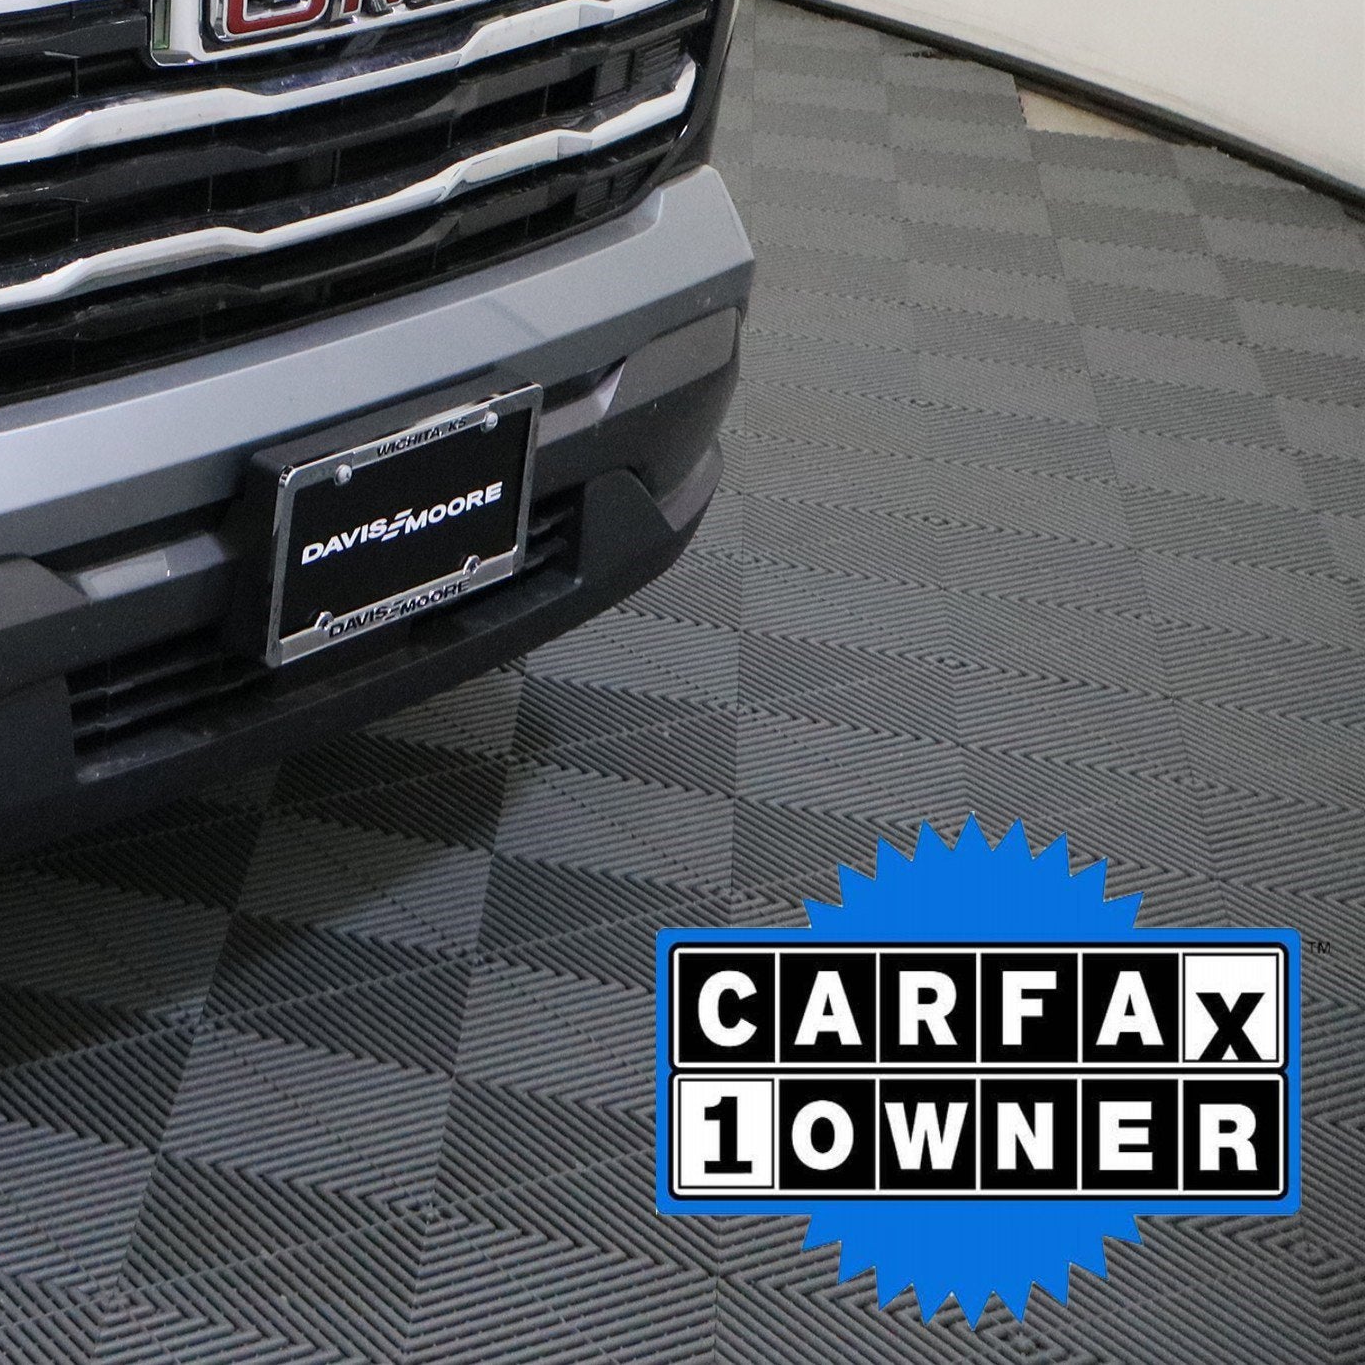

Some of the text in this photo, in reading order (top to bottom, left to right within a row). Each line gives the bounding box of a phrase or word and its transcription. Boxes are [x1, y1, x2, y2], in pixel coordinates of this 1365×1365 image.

[301, 481, 503, 565] DAVIS MOORE
[329, 578, 470, 638] DAVIS MOORE
